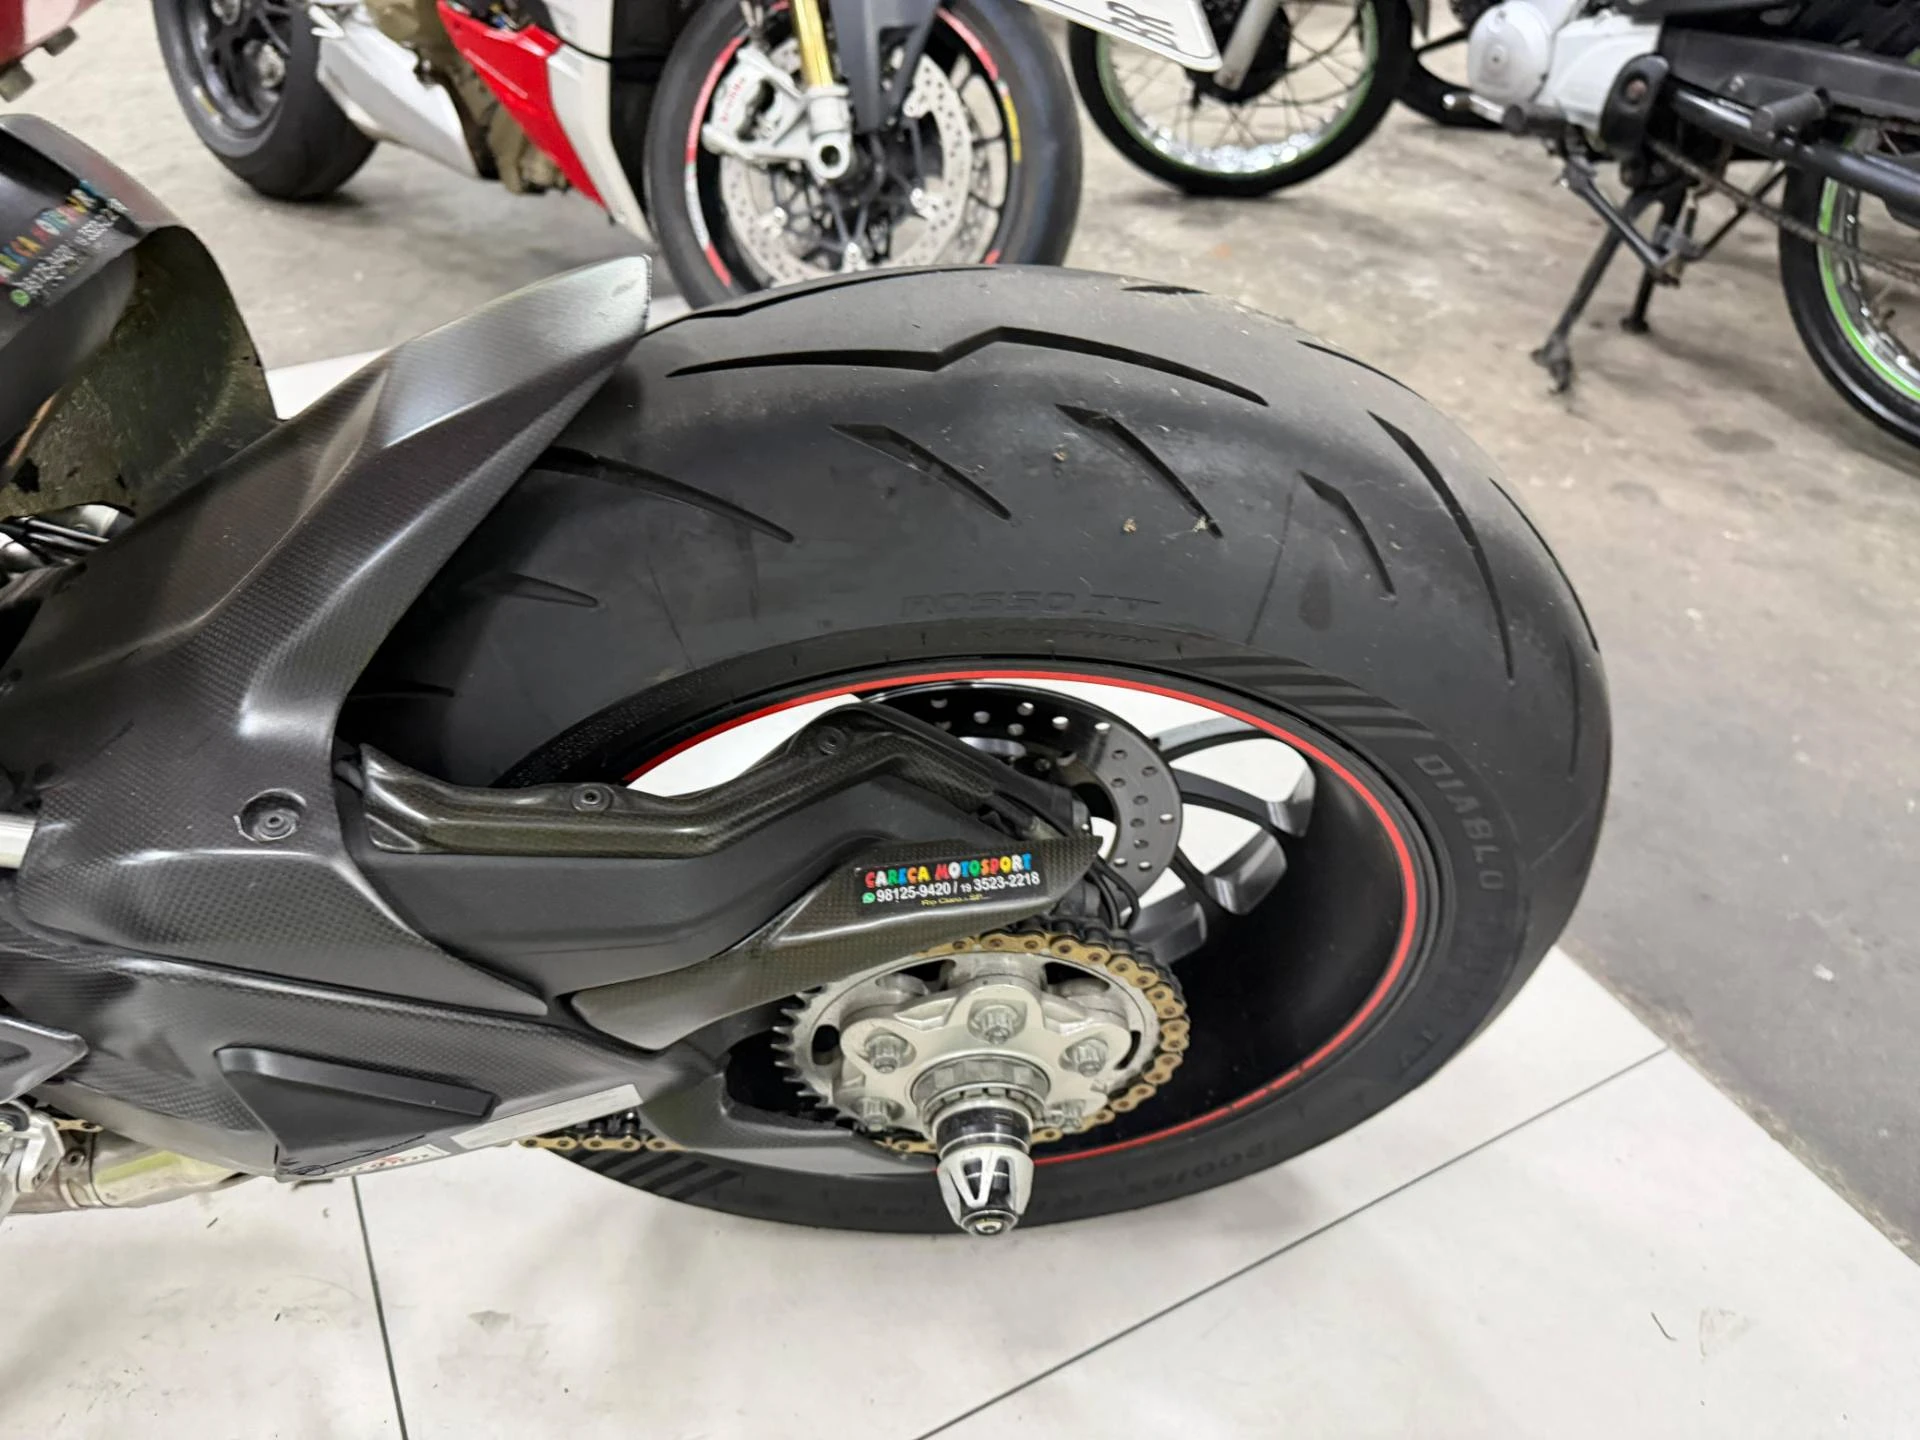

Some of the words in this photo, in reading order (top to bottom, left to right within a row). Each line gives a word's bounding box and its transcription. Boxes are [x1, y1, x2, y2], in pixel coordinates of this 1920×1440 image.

[1413, 755, 1504, 891] DIABLO
[865, 866, 931, 888] CARECA
[934, 853, 1033, 881] MOTOSPORT
[876, 881, 950, 902] 98125-9420
[973, 871, 1041, 892] 3523-2218
